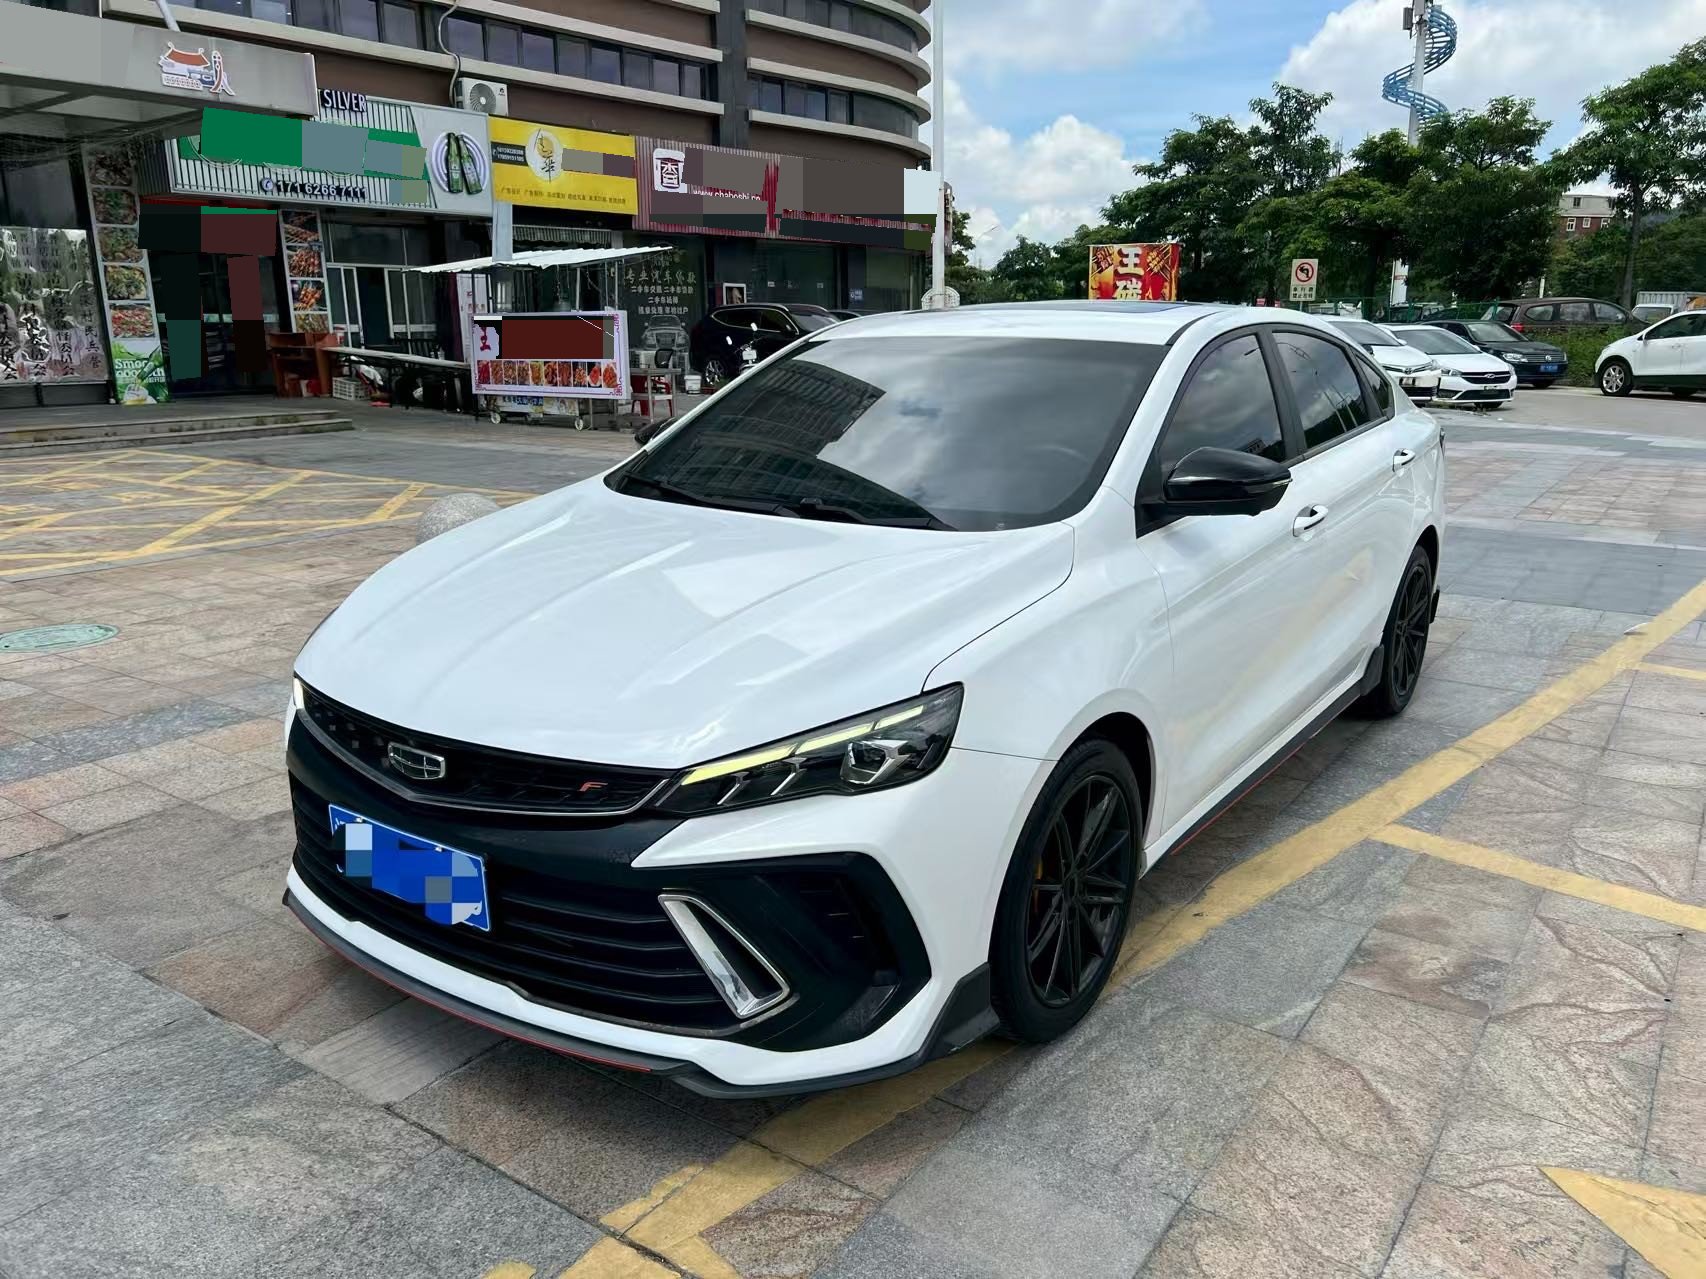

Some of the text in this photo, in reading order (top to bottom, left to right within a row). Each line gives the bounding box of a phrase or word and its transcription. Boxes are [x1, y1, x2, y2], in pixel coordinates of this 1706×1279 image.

[323, 89, 366, 112] SILVER
[277, 180, 301, 193] 171
[304, 182, 337, 196] 6266
[579, 781, 608, 792] F
